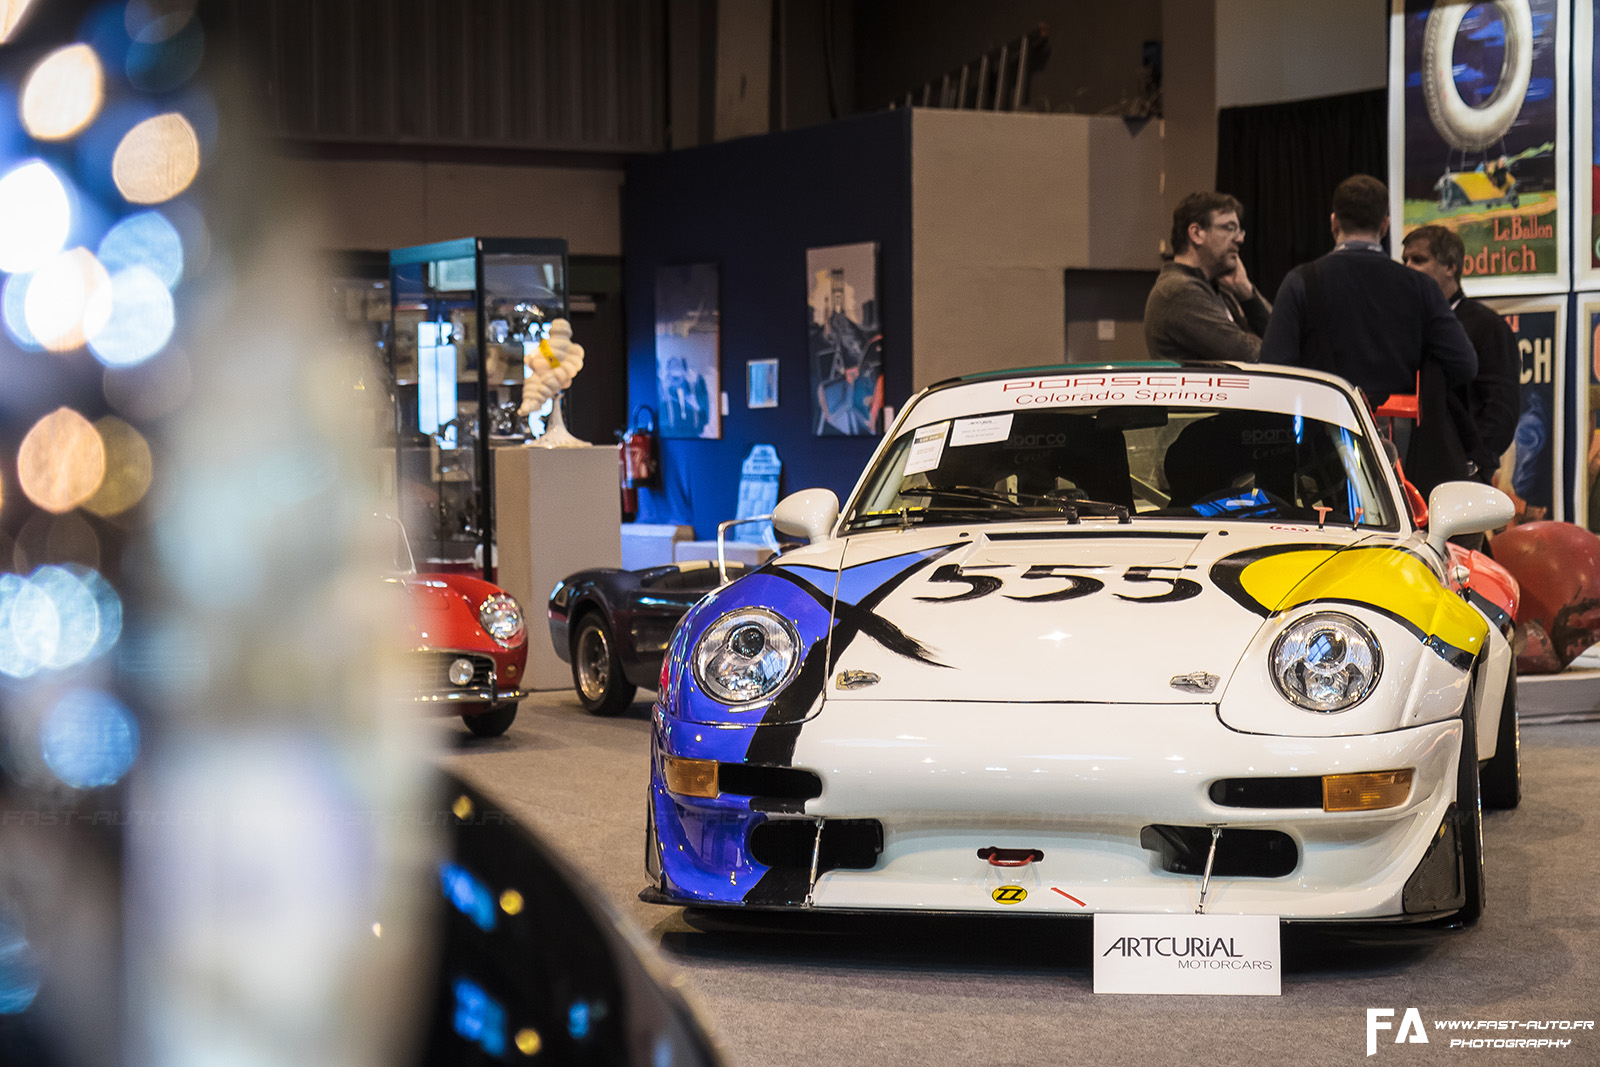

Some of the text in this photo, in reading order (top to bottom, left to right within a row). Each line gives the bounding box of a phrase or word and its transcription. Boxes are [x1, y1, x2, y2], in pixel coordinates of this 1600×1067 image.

[1494, 215, 1554, 241] Le Ballon
[1462, 244, 1537, 275] odrich
[1517, 337, 1552, 384] CH
[1003, 376, 1250, 393] PORSCHE
[1015, 389, 1228, 405] Colorado Springs
[1178, 959, 1273, 970] MOTORCARS
